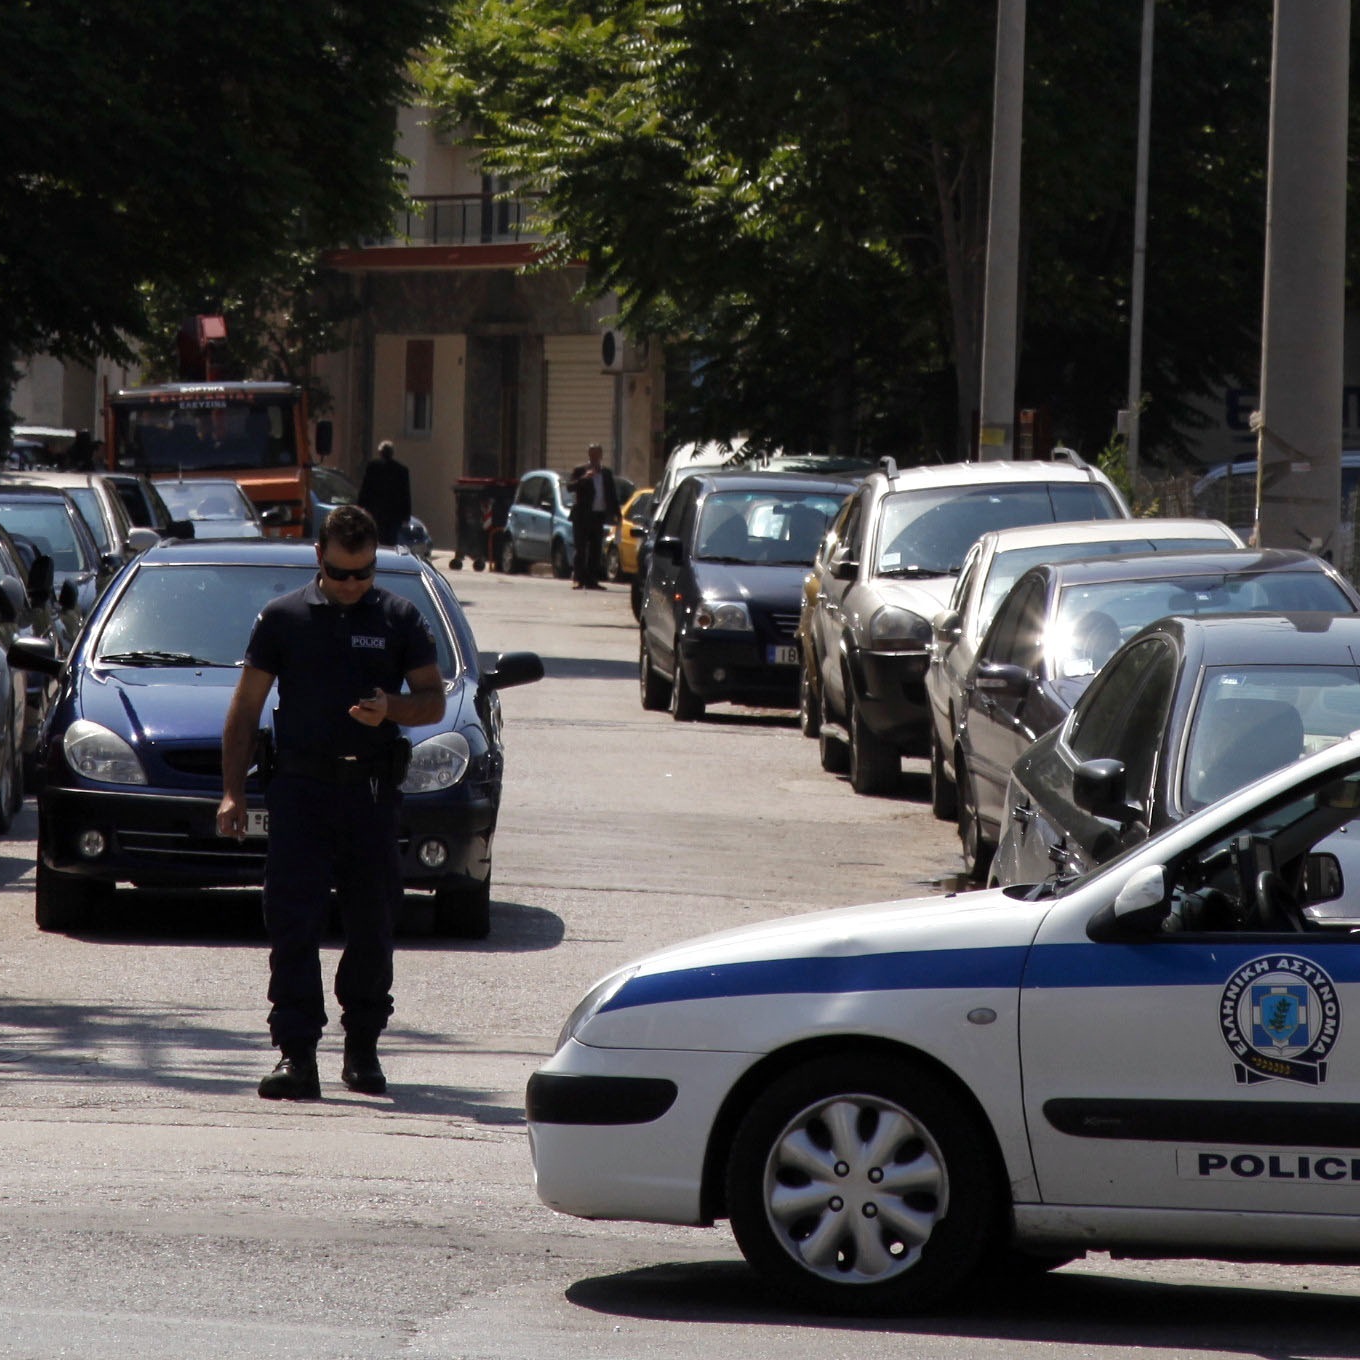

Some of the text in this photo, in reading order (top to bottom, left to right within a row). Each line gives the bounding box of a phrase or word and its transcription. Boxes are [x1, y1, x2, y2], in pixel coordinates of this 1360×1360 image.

[352, 637, 385, 648] POLICE
[1222, 958, 1337, 1057] ΕΛΛΗΝΙΚΗ ΑΣΤΥΝΟΜΙΑ
